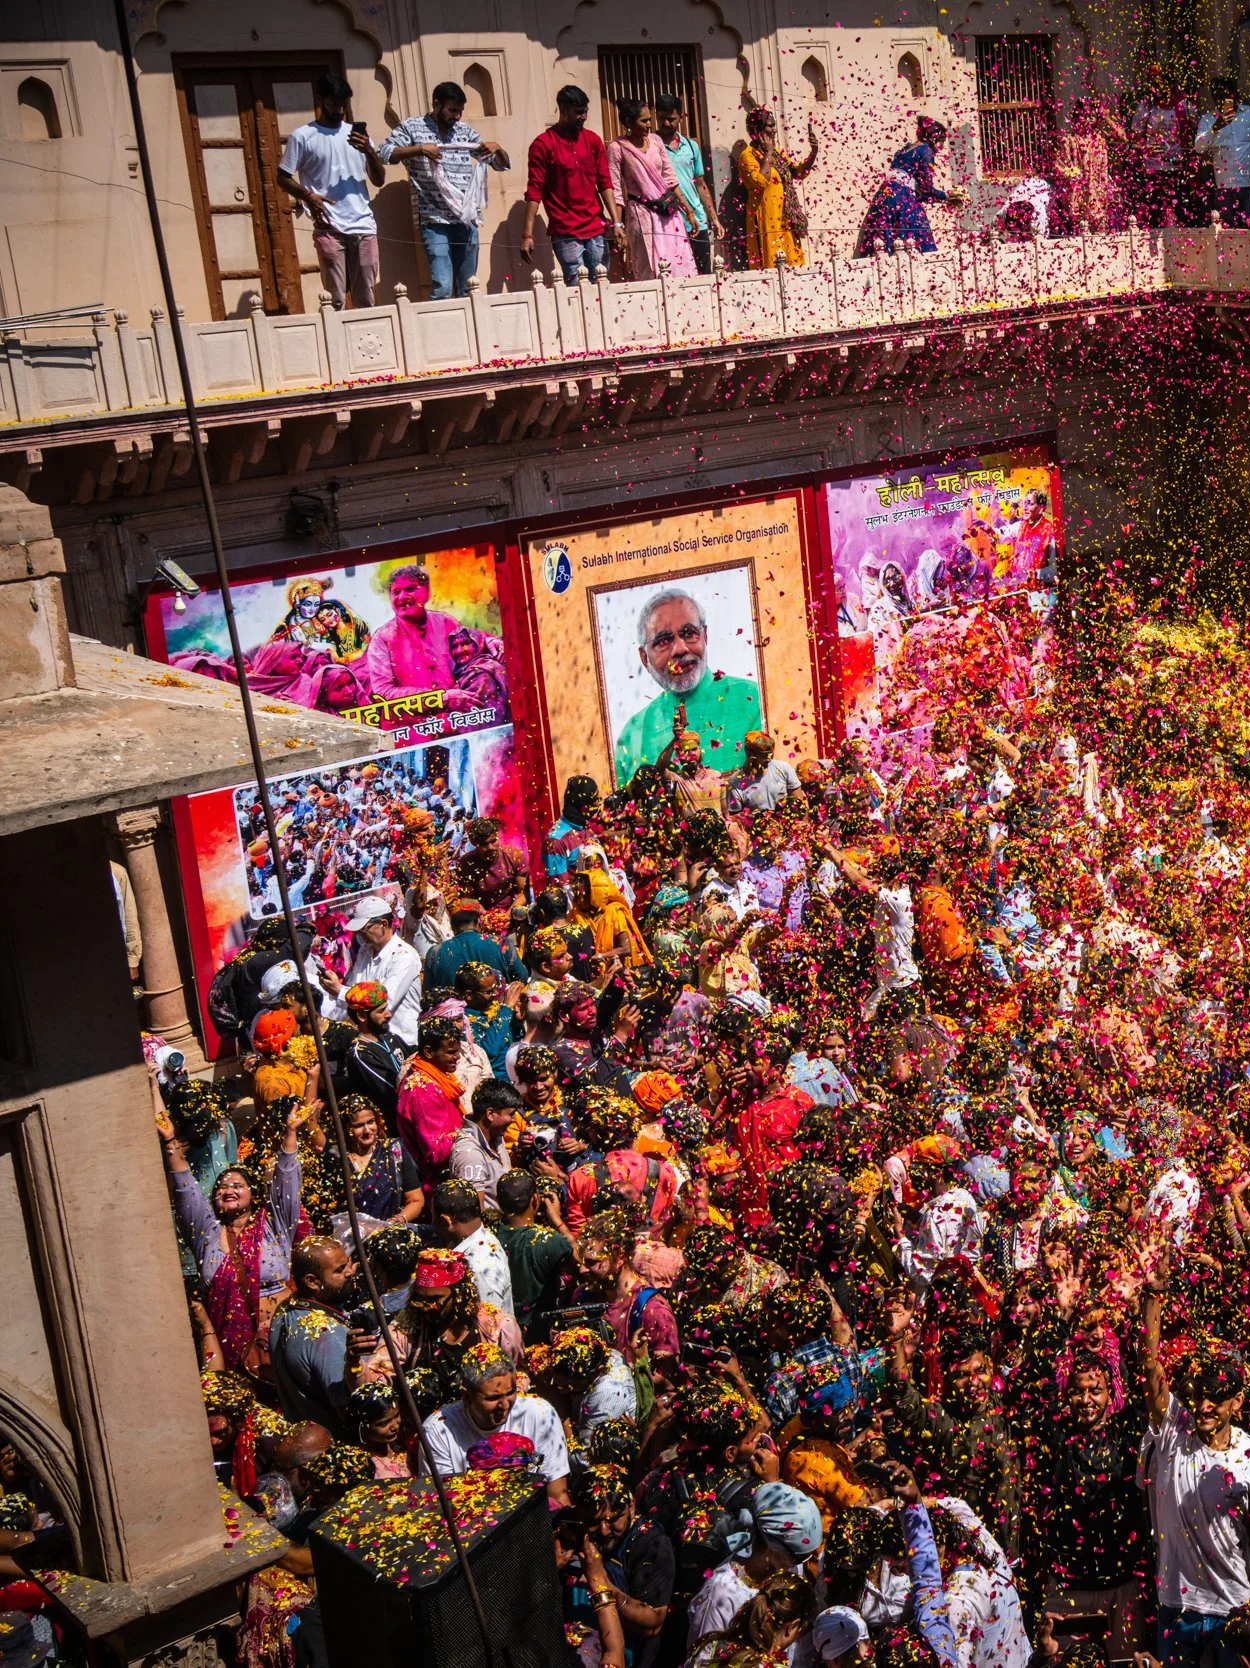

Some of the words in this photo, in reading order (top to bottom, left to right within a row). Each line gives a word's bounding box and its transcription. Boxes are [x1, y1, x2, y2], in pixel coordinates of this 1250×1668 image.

[865, 513, 888, 530] सुलभ
[541, 542, 570, 556] SULABH
[582, 552, 614, 569] Sulabh
[615, 541, 672, 563] International
[673, 536, 700, 552] Social
[702, 532, 734, 548] Service
[735, 523, 789, 543] Organisation
[339, 688, 447, 727] महोत्सव
[415, 717, 444, 736] फॉर
[450, 707, 496, 729] विडोस
